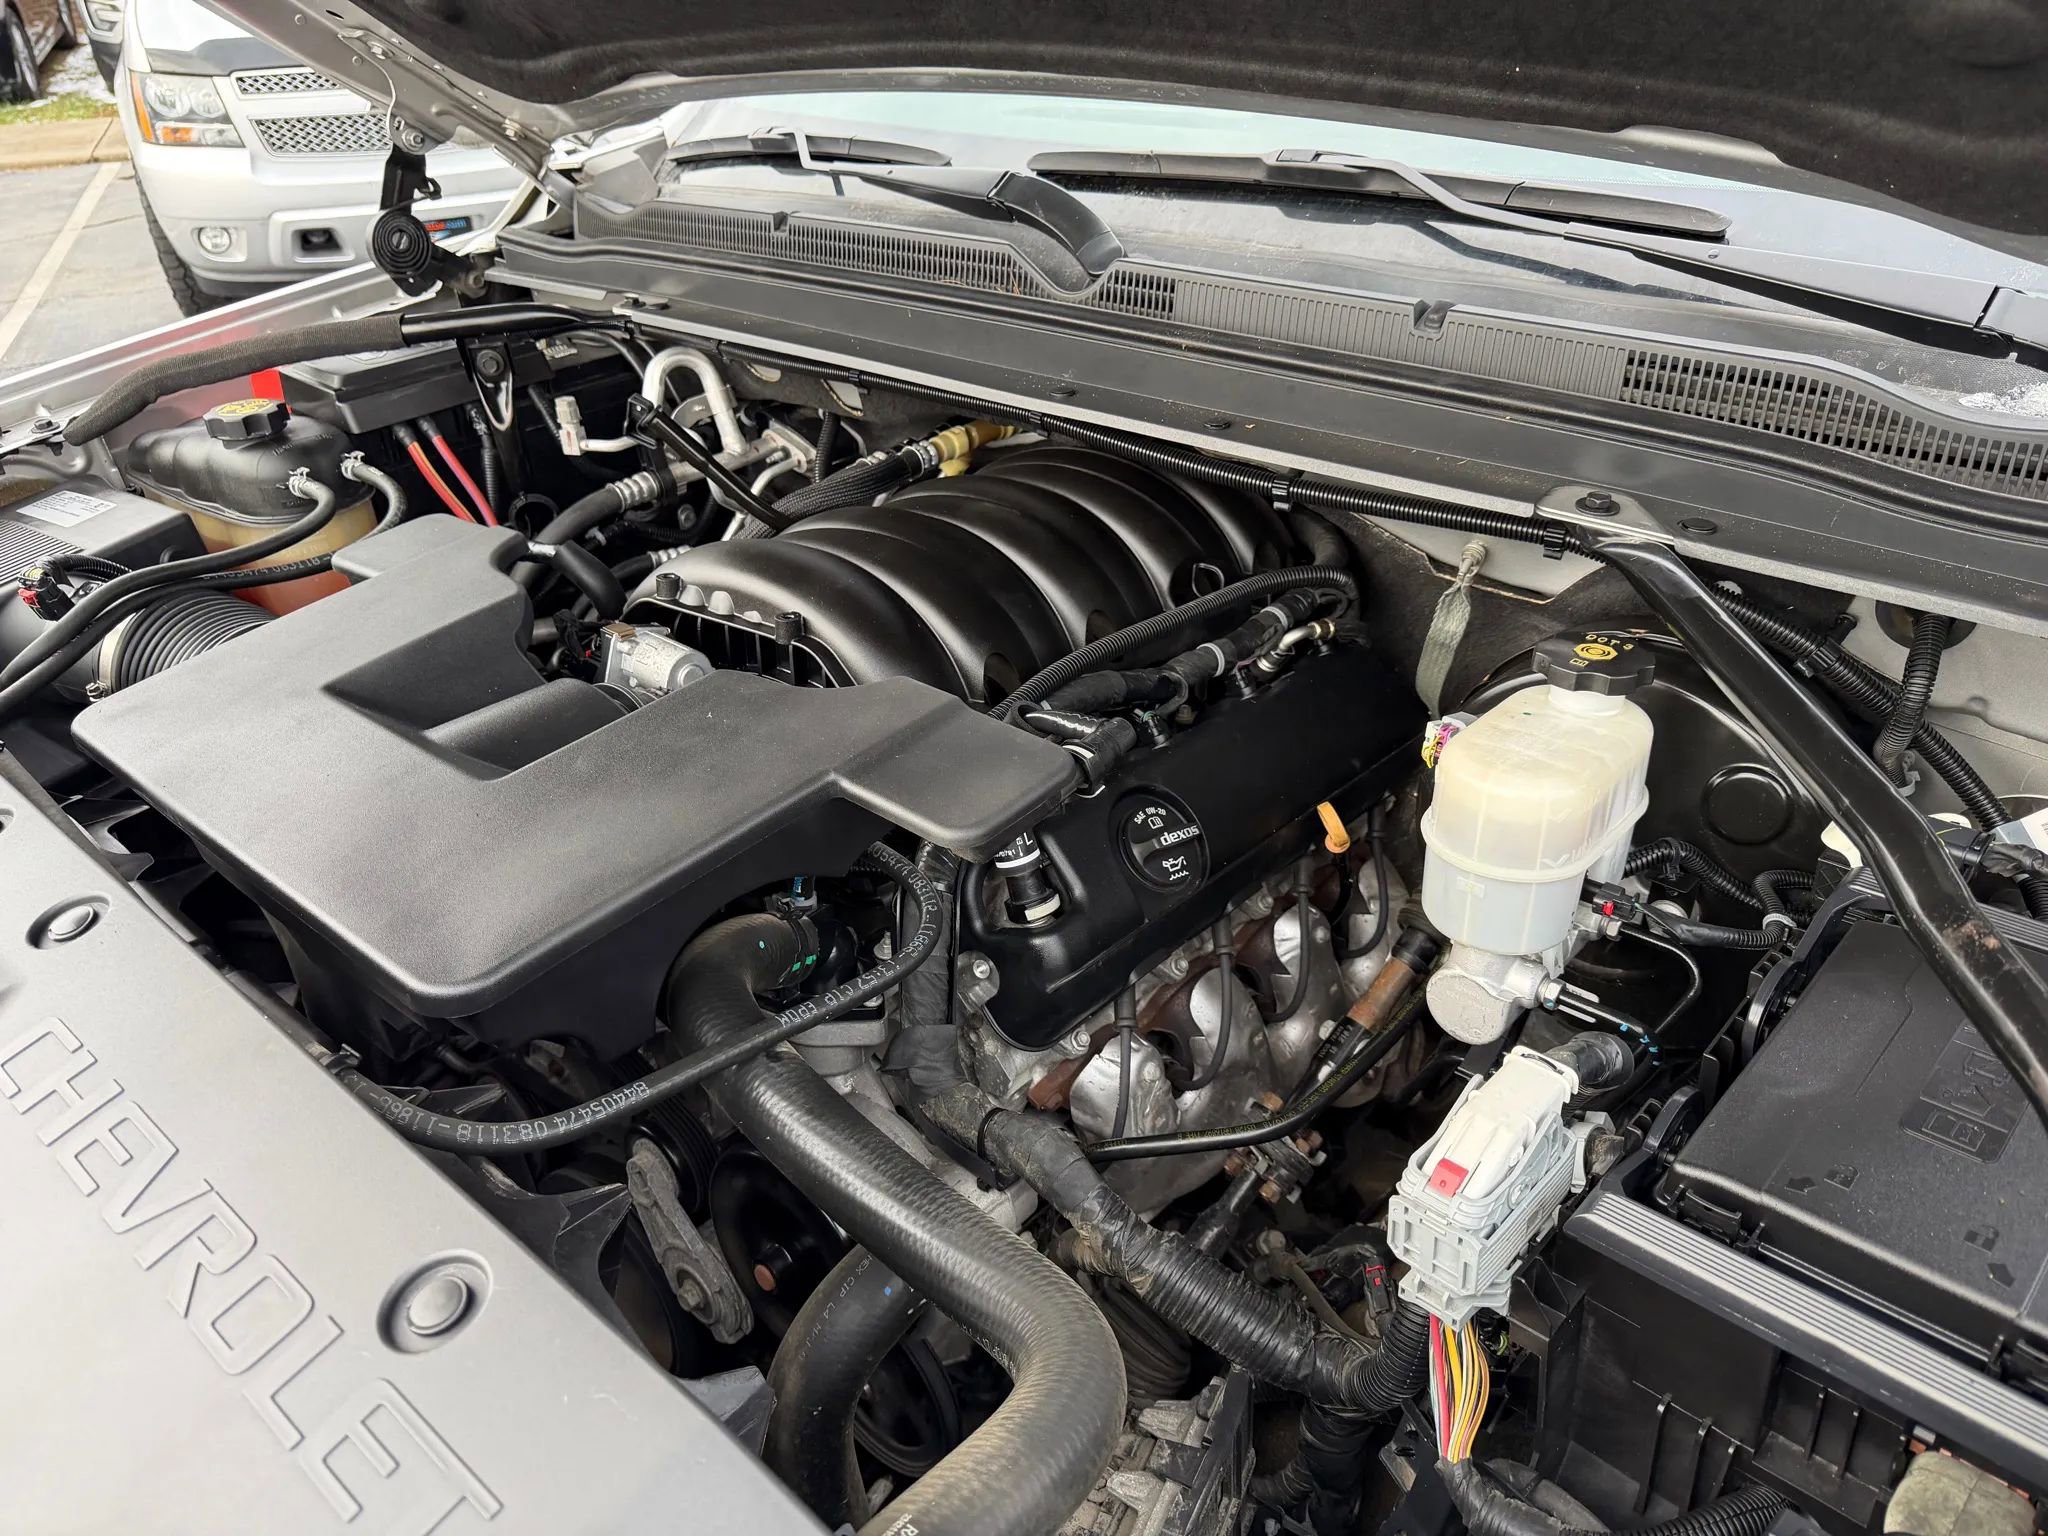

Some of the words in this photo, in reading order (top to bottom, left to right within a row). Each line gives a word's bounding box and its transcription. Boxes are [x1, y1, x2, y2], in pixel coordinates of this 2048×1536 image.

[1585, 634, 1620, 646] DOT
[1622, 643, 1635, 651] 3
[1134, 811, 1146, 824] SAE
[1145, 807, 1167, 816] 0W-20
[1159, 824, 1200, 846] dexos
